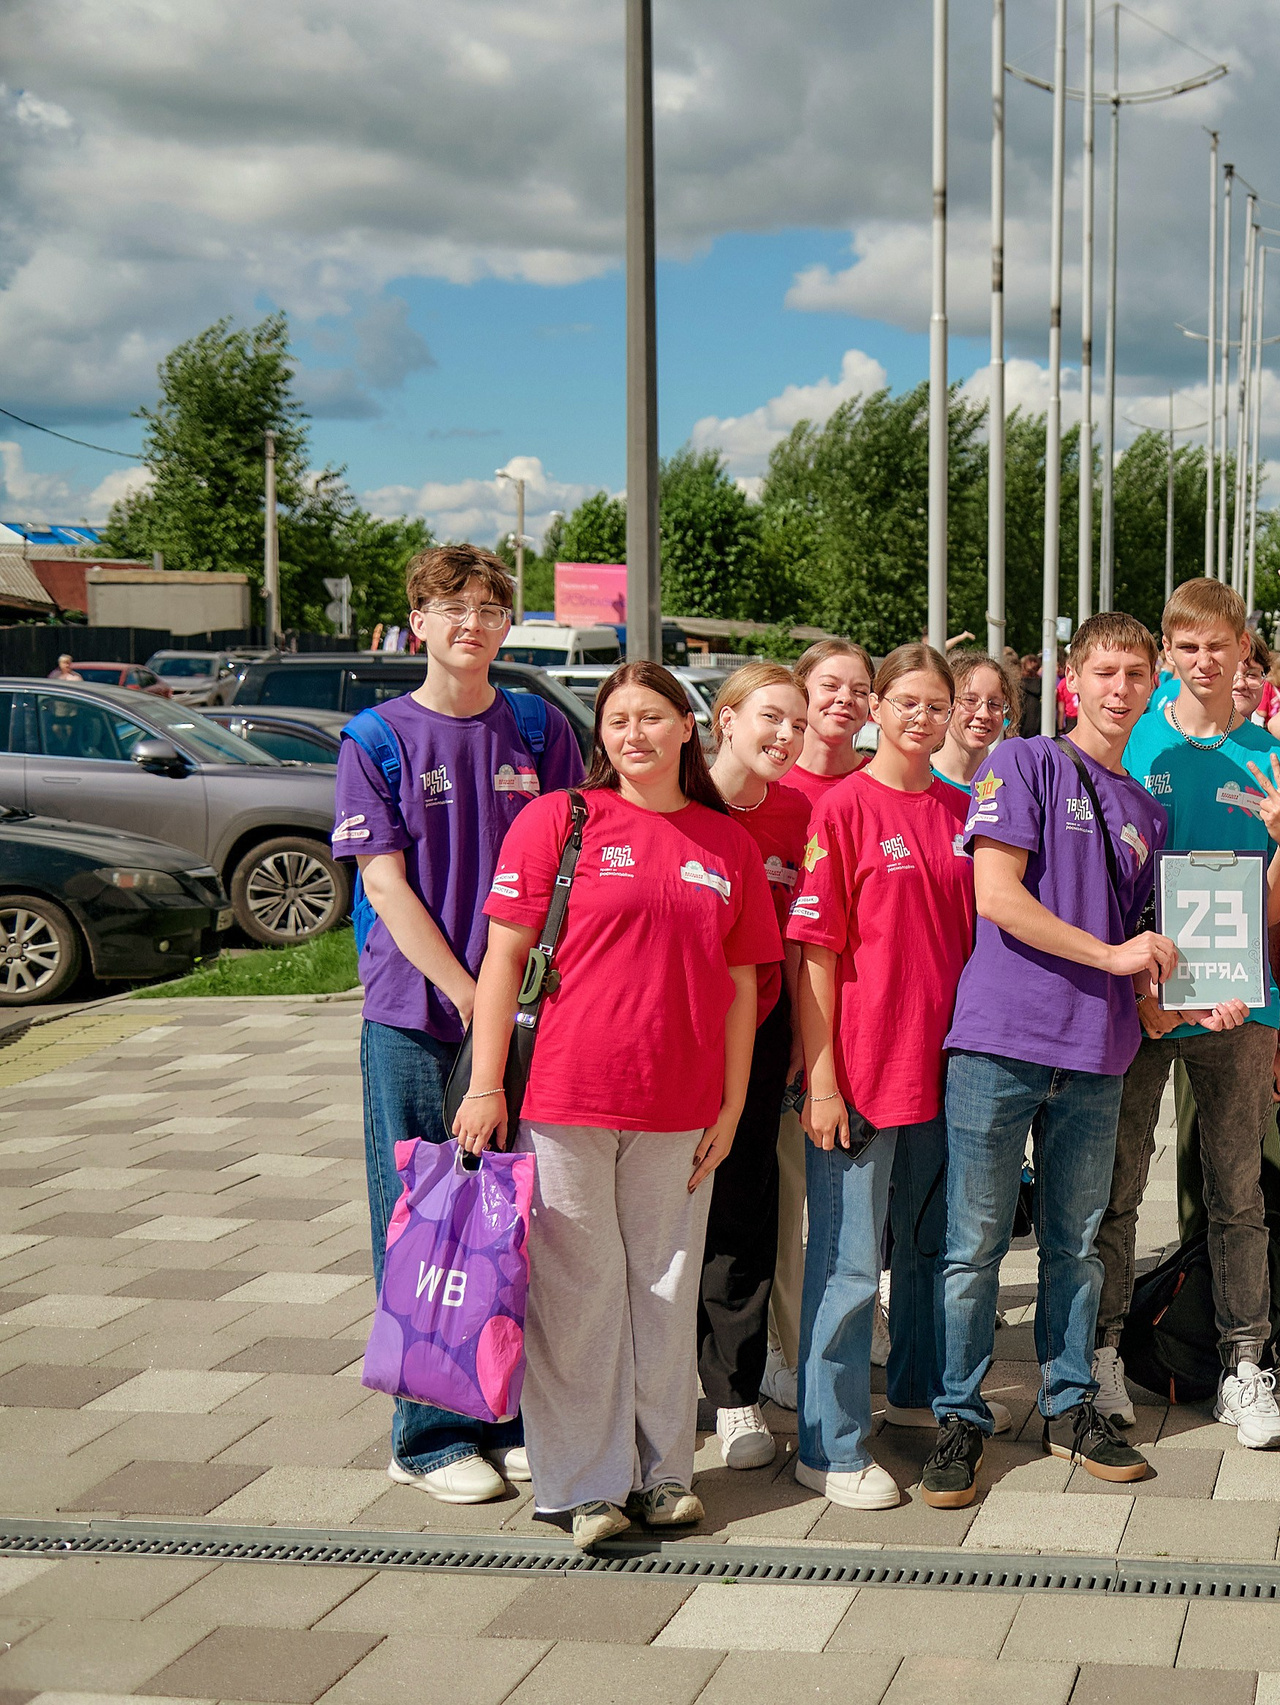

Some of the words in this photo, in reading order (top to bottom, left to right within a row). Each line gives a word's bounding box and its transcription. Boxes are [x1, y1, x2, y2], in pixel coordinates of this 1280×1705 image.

[982, 781, 994, 796] 10
[807, 847, 815, 862] 9
[1177, 890, 1248, 948] 23
[1178, 962, 1249, 982] ОТРЯД
[415, 1261, 468, 1307] WB
